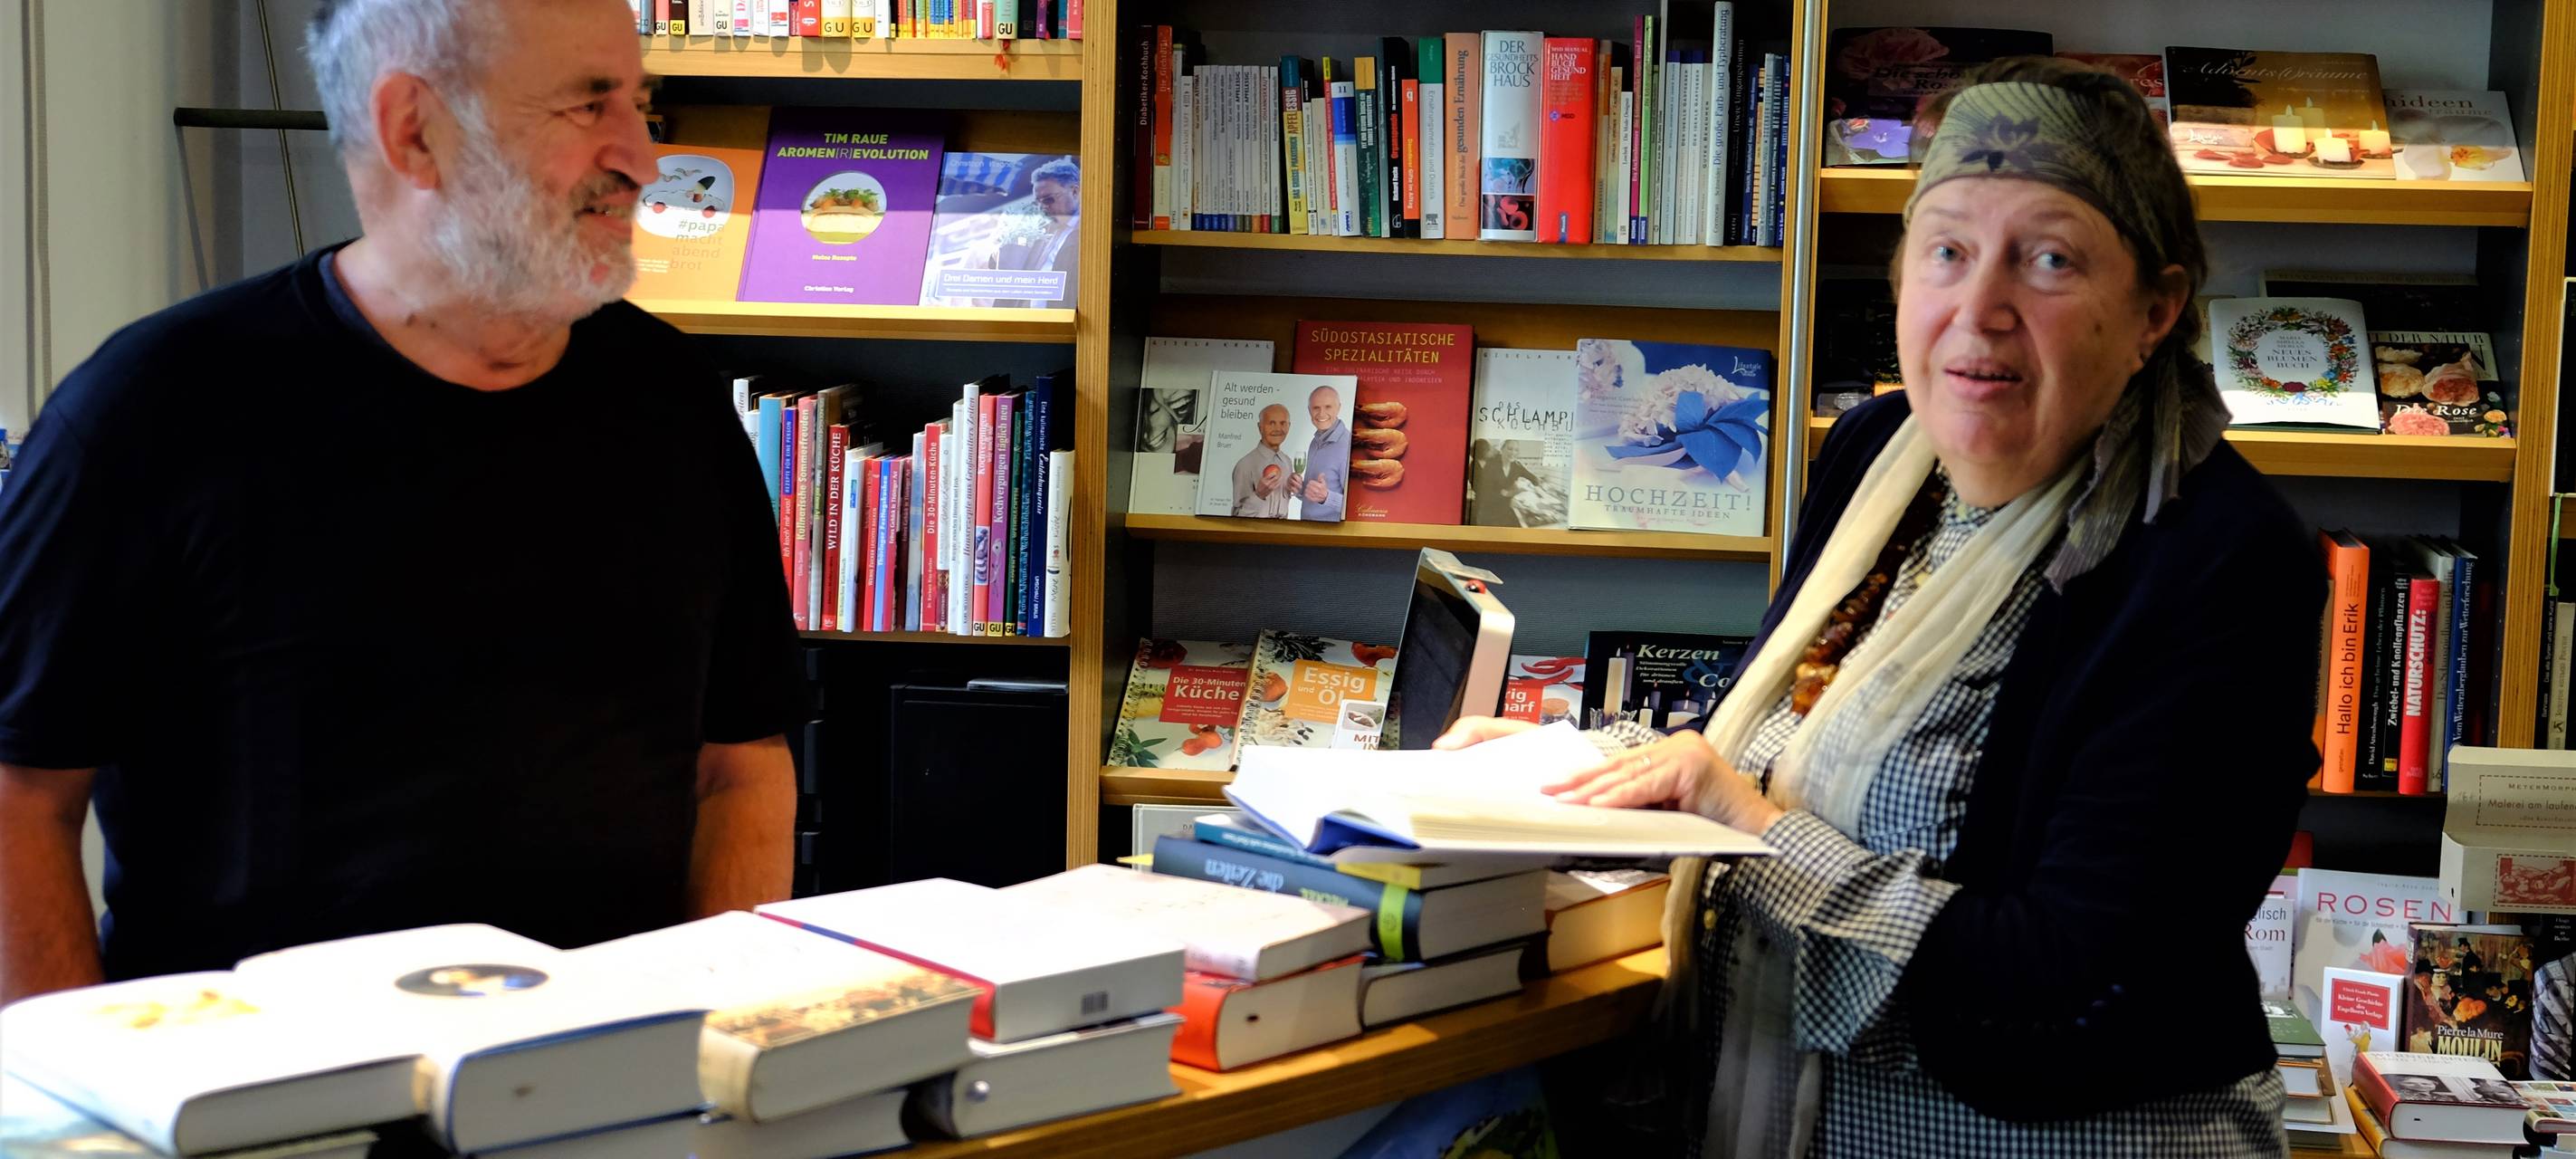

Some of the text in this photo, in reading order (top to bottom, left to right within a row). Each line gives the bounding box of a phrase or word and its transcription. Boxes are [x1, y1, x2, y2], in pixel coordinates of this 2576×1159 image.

[655, 22, 666, 31] GU
[672, 24, 682, 32] GU
[716, 21, 728, 30] GU
[824, 22, 844, 33] GU
[852, 22, 873, 33] GU
[997, 23, 1013, 34] GU
[1499, 40, 1525, 53] DER
[1486, 53, 1539, 62] GESUNDHEITS
[1550, 53, 1577, 61] HAND
[1489, 62, 1534, 74] BROCK
[1550, 66, 1586, 74] GESUND
[1139, 40, 1150, 126] Diabetiker-Kochbuch
[1493, 74, 1530, 88] HAUS
[1550, 72, 1570, 81] HEIT
[1713, 9, 1729, 166] Die große und Typberatung
[1453, 50, 1469, 153] gesunden Ernährung
[824, 133, 888, 145] TIM RAUE
[1389, 113, 1399, 159] Organspende
[1407, 192, 1415, 210] Alltag
[678, 218, 725, 234] #papa
[675, 234, 723, 245] macht
[673, 244, 720, 259] abend
[670, 258, 702, 271] brot
[943, 273, 1057, 284] Drei Damen und mein Herd
[1310, 328, 1455, 347] SÜDOSTASIATISCHE
[2388, 332, 2484, 344] DER NATUR
[1323, 348, 1439, 363] SPEZIALITÄTEN
[1223, 382, 1273, 394] Alt werden
[1222, 396, 1255, 407] gesund
[1498, 400, 1520, 410] DAS
[966, 398, 975, 426] Zeiten
[1220, 408, 1253, 419] bleiben
[2436, 405, 2477, 416] Rose
[1038, 414, 1047, 450] kulinarische
[1217, 432, 1242, 440] Manfred
[797, 409, 809, 483] Sommerfreuden
[829, 433, 841, 472] KÜCHE
[995, 404, 1008, 523] Kochvergnügen täglich neu
[829, 476, 839, 499] DER
[926, 442, 938, 534] Die 30-Minuten-Küche
[1584, 484, 1751, 512] HOCHZEIT!
[797, 485, 807, 541] Kulinarische
[828, 503, 838, 515] IN
[1603, 504, 1730, 519] TRAUMHAFTE IDEEN
[827, 516, 838, 551] WILD
[2377, 587, 2386, 618] Pflanzen
[2342, 603, 2359, 634] Erik
[973, 622, 985, 632] GU
[988, 623, 1001, 633] GU
[1635, 644, 1720, 660] Kerzen
[2341, 637, 2357, 662] bin
[2452, 561, 2474, 742] Vom Wetteraberglauben zur Wetterforschung
[2387, 592, 2406, 726] Zwiebel- und Knollenpflanzen
[2405, 609, 2426, 716] NATURSCHUTZ:
[1172, 676, 1245, 687] Die 30-Minuten
[1303, 667, 1366, 694] Essig
[2339, 666, 2354, 689] ich
[1173, 685, 1240, 701] Küche
[1297, 685, 1314, 694] und
[2336, 694, 2352, 734] Hallo
[2369, 702, 2380, 746] Attenborough
[1353, 733, 1379, 743] MIT
[2368, 746, 2376, 765] David
[2487, 800, 2524, 809] Malerei
[2527, 801, 2542, 809] am
[1205, 857, 1285, 894] die Zeiten
[2317, 891, 2451, 922] ROSEN
[2244, 924, 2285, 942] Rom
[2337, 993, 2383, 1007] Kleine Geschichte
[2437, 1025, 2504, 1039] Pierre la Mure
